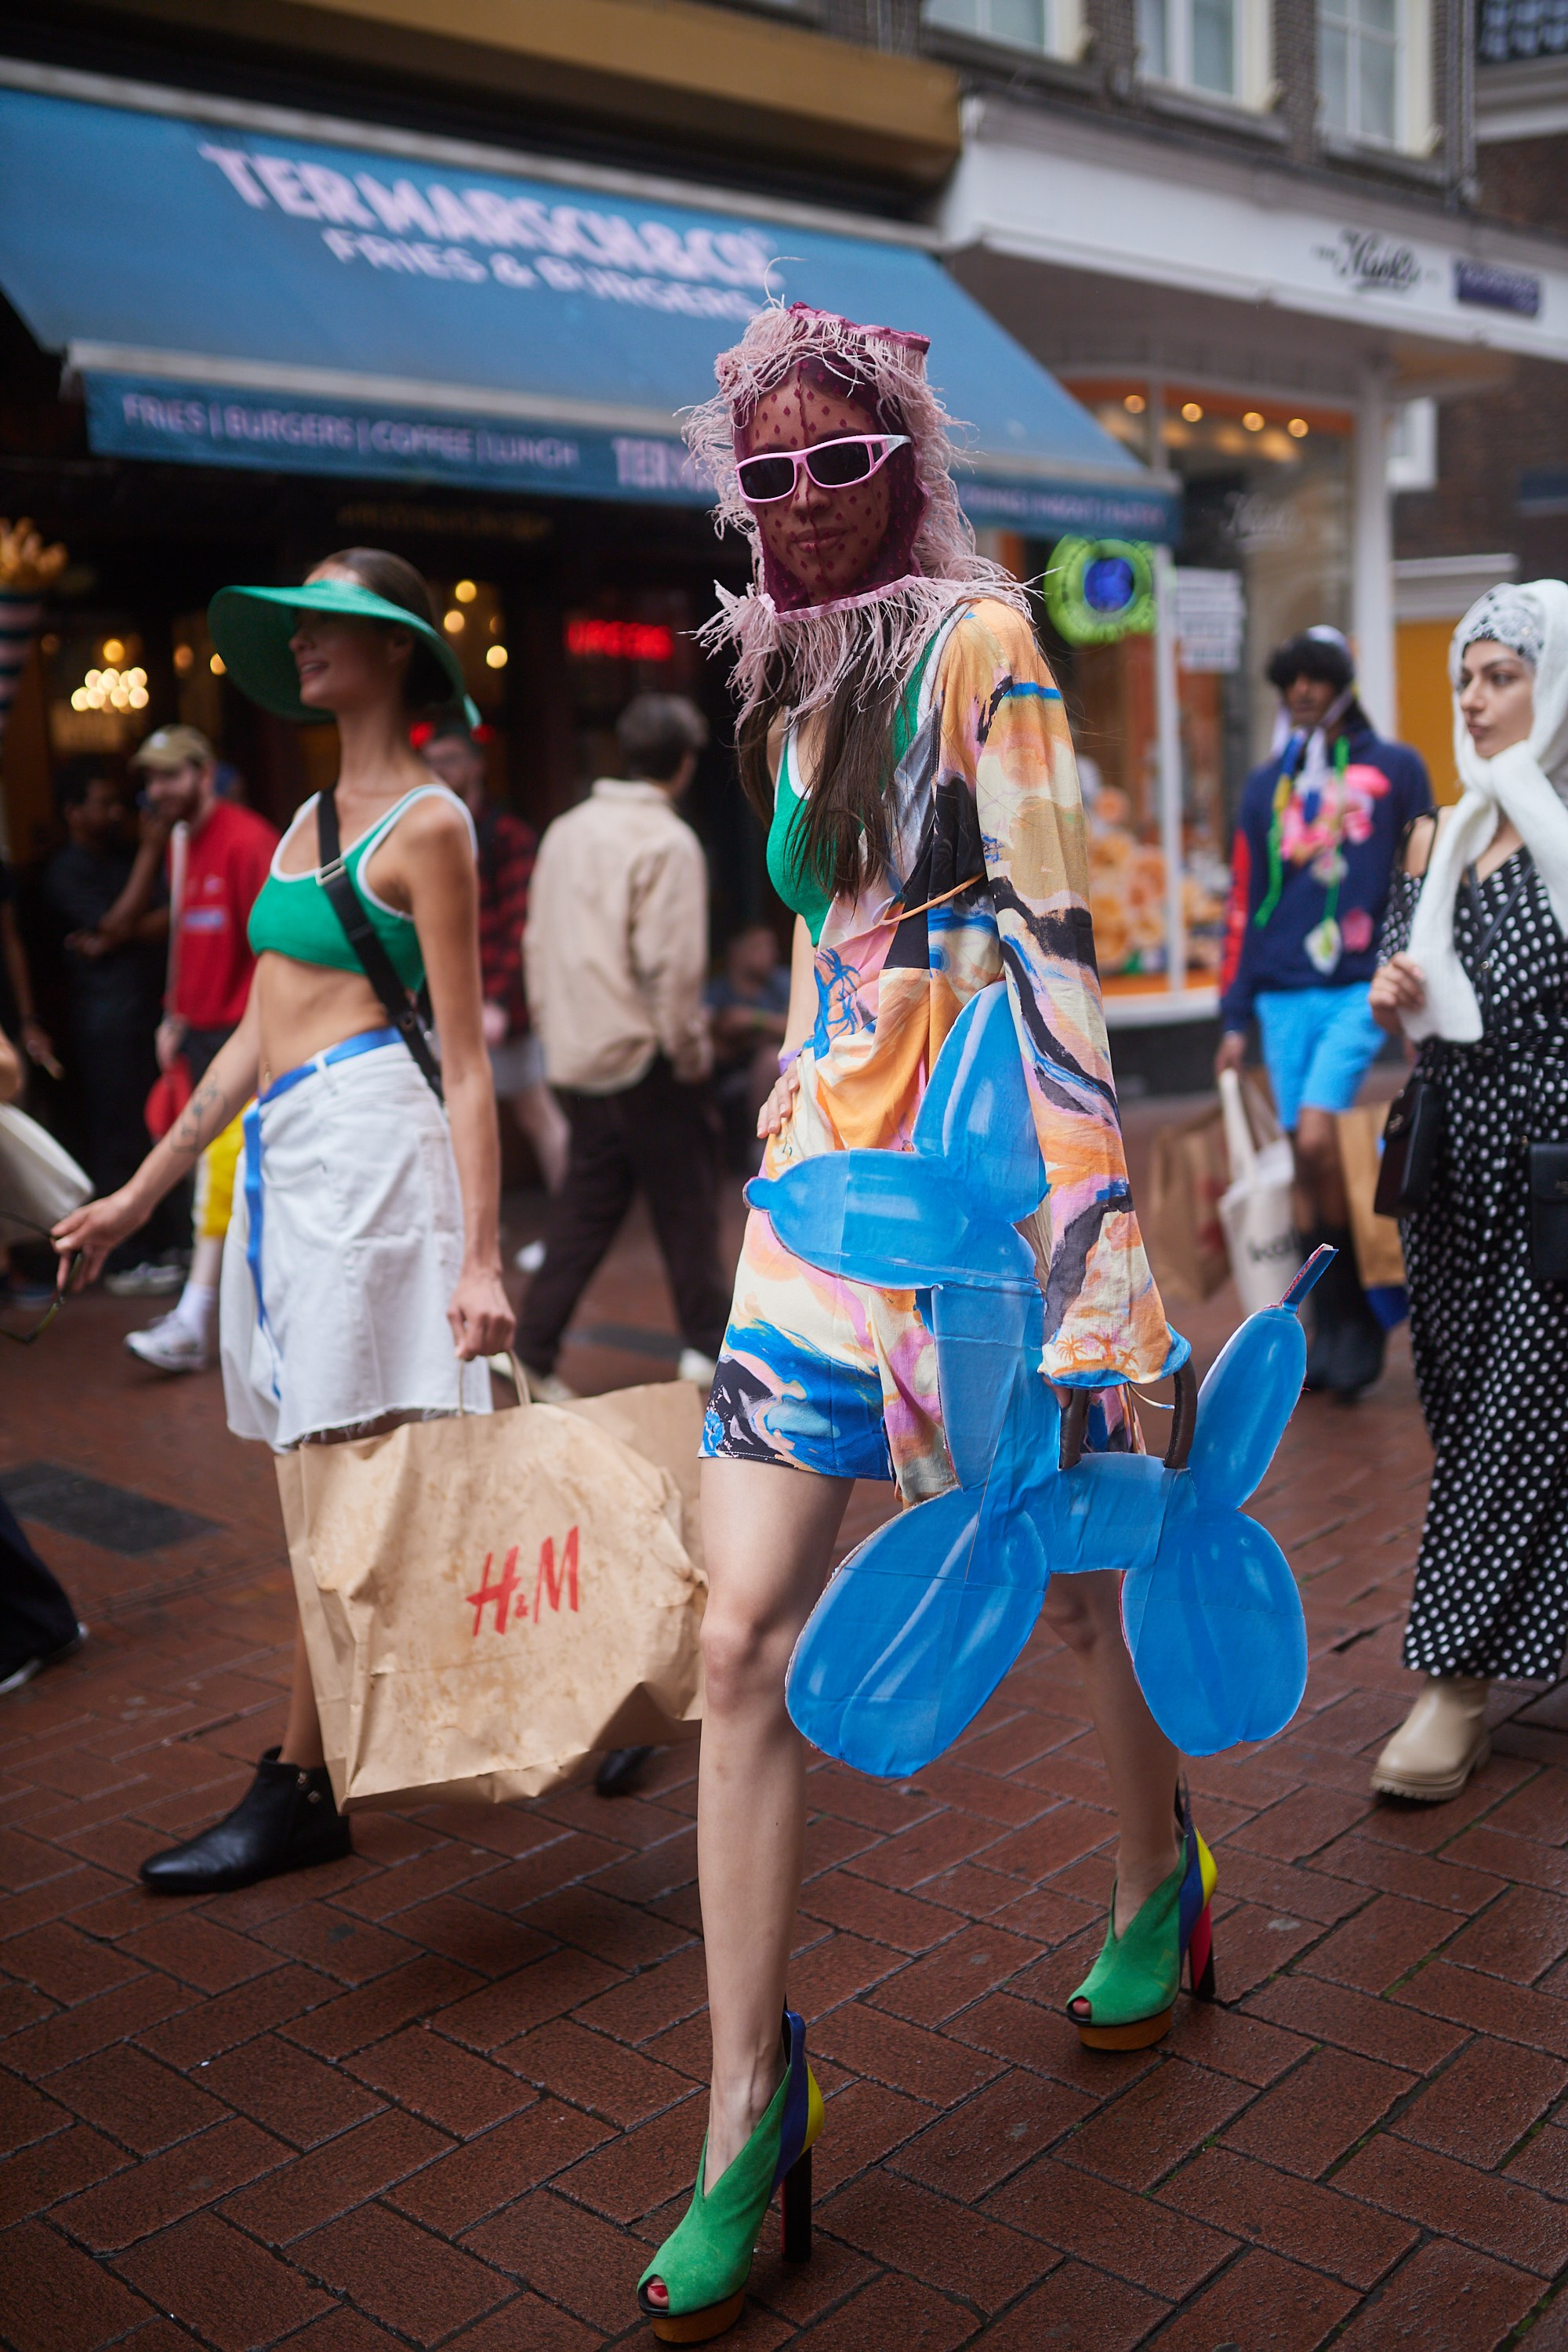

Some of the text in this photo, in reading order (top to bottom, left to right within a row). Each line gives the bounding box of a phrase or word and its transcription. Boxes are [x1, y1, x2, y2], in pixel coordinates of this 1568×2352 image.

[321, 226, 489, 284] FRIES
[489, 252, 541, 289] &
[122, 393, 208, 434] FRIES
[223, 404, 354, 451] BURGERS
[370, 419, 473, 460] COFFEE
[465, 1525, 579, 1637] H&M
